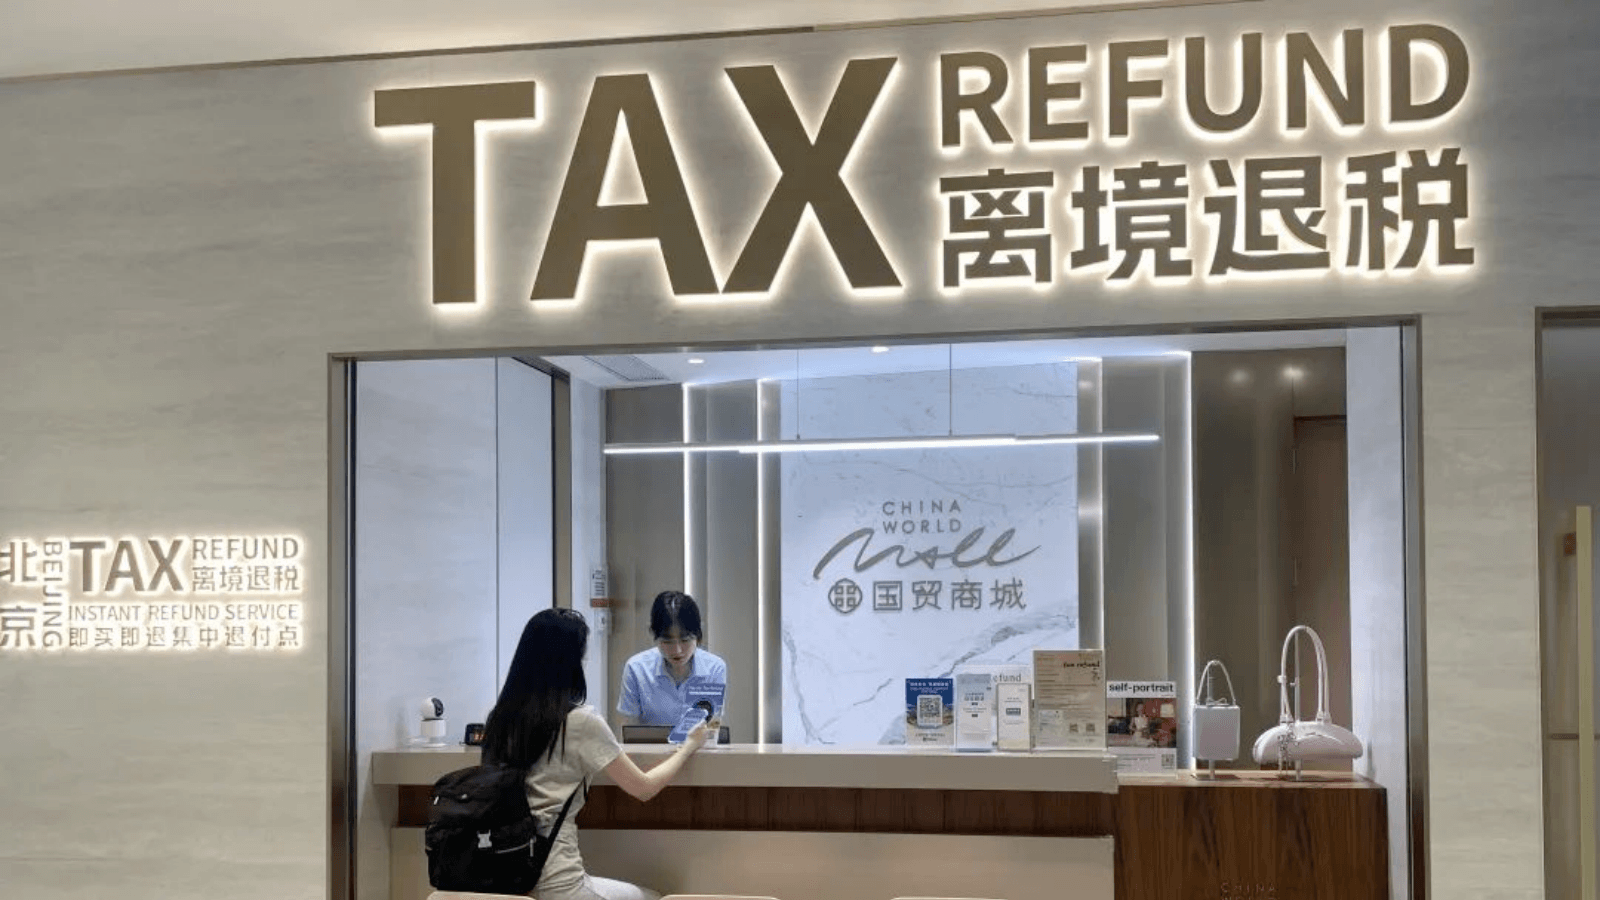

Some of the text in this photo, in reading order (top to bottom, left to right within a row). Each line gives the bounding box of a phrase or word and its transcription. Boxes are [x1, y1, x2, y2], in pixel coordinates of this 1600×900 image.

[374, 24, 1470, 304] TAX REFUND
[939, 148, 1475, 288] 离境退税
[882, 500, 962, 516] CHINA
[883, 519, 962, 534] WORLD
[69, 538, 299, 592] TAX REFUND
[192, 566, 300, 591] 离境退税
[0, 542, 37, 647] 北京
[43, 541, 62, 647] BEIJING
[873, 577, 1027, 611] 国贸商城
[68, 603, 298, 621] INSTANT REFUND SERVICE
[69, 626, 298, 647] 即买即退集中退付点
[992, 674, 1021, 683] efund
[1109, 683, 1174, 693] self-portrait
